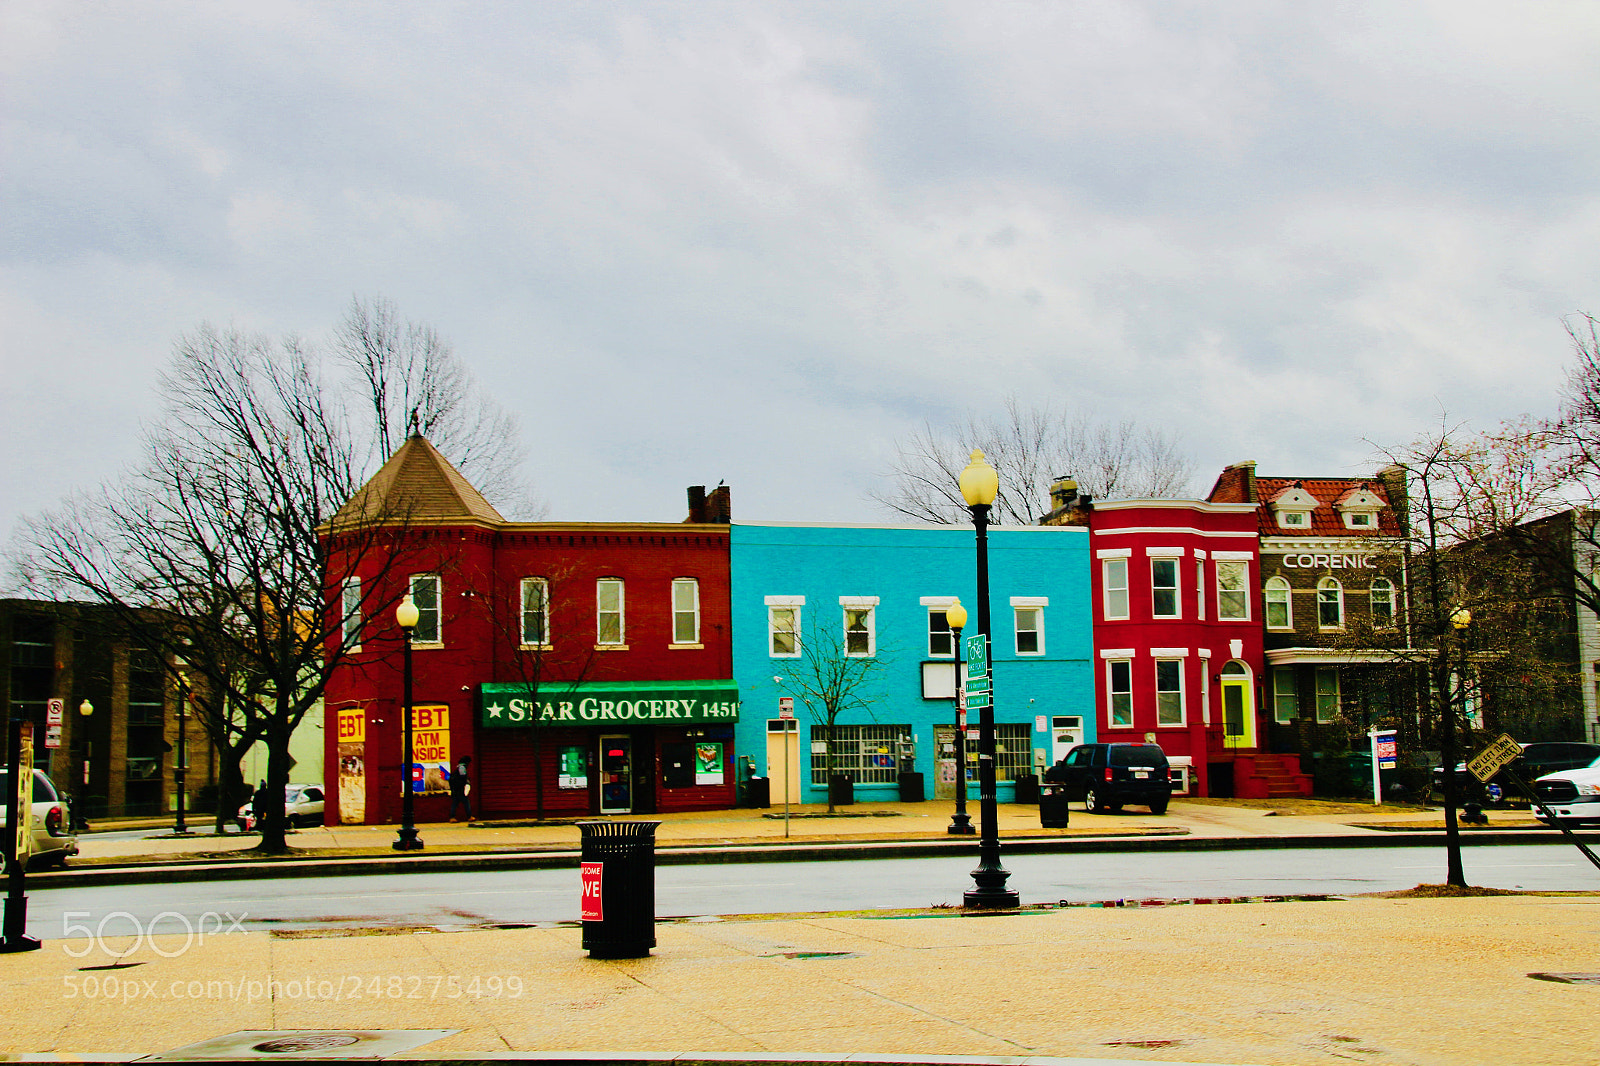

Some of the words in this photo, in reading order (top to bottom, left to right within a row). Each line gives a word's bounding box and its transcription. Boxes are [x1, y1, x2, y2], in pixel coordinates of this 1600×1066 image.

[1282, 553, 1377, 569] CORENIC
[508, 698, 576, 721] STAR
[579, 698, 697, 720] GROCERY
[339, 714, 364, 738] EBT
[415, 732, 440, 746] ATM
[412, 747, 446, 761] NSIDE
[1471, 762, 1482, 771] NO
[1480, 751, 1495, 764] LEFT
[1494, 738, 1511, 752] TURN
[1477, 765, 1492, 778] INTO
[1496, 744, 1518, 763] STREET
[581, 881, 600, 897] VE
